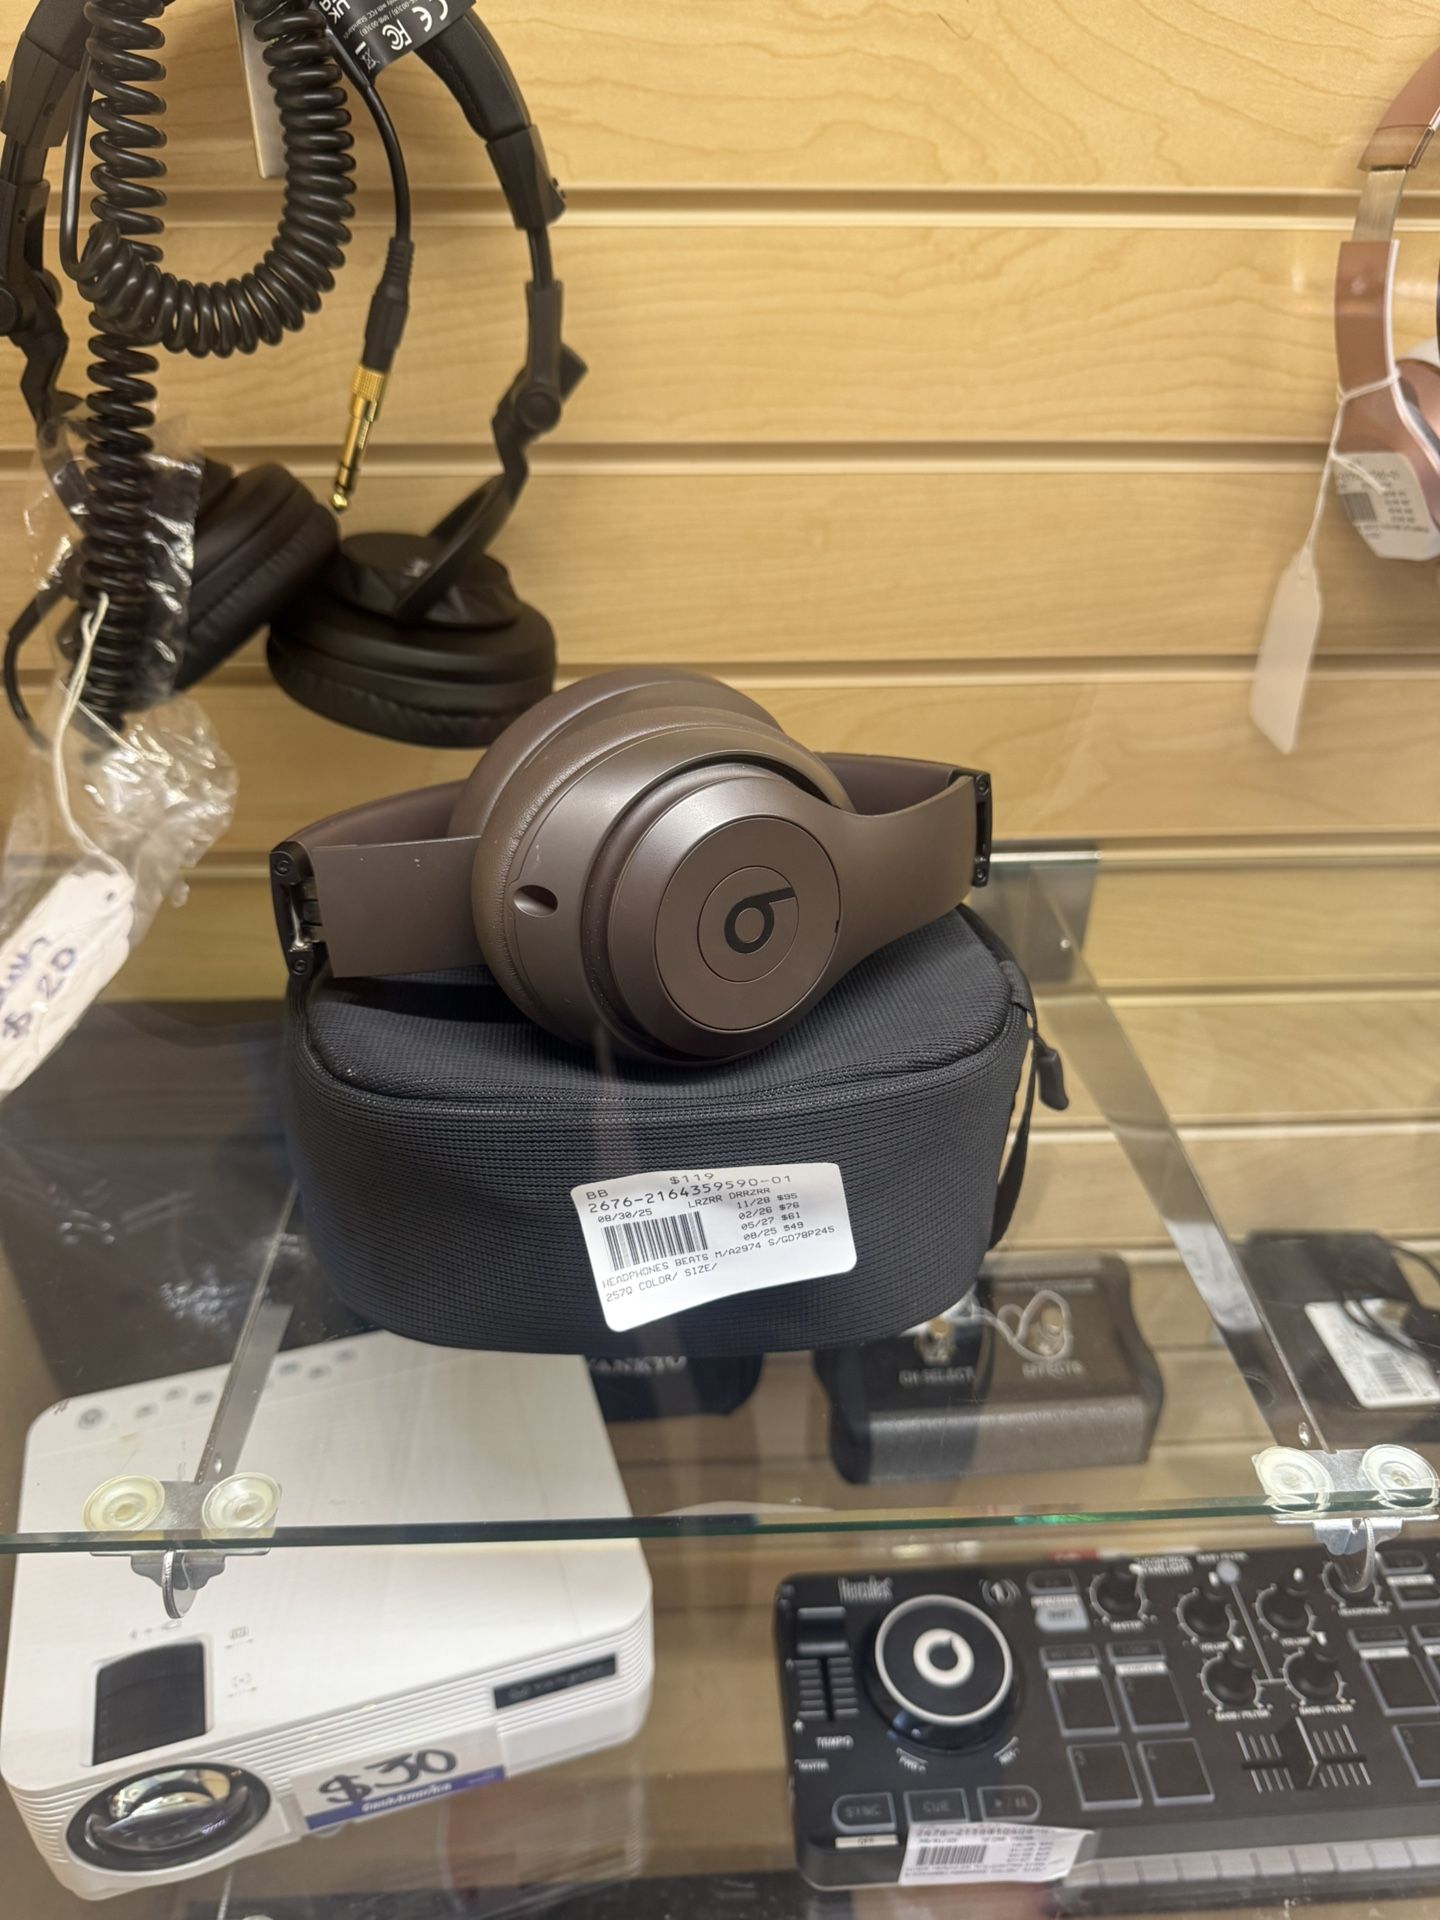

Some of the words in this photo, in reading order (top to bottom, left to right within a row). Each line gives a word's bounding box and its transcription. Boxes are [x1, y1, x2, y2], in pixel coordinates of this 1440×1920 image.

[669, 1172, 714, 1185] $119
[586, 1189, 609, 1200] BB
[588, 1175, 792, 1213] 2676-2164359590-01
[776, 1192, 798, 1201] $95
[598, 1208, 653, 1223] 08/30/25
[738, 1206, 773, 1220] 02/26
[741, 1216, 775, 1230] 05/27
[743, 1227, 777, 1241] 08/25
[602, 1261, 669, 1288] HEADPHONES
[674, 1253, 709, 1266] BEATS
[714, 1241, 762, 1258] M/A2974
[638, 1271, 678, 1291] COLOR/
[684, 1262, 717, 1277] SIZE/
[318, 1749, 458, 1804] $30
